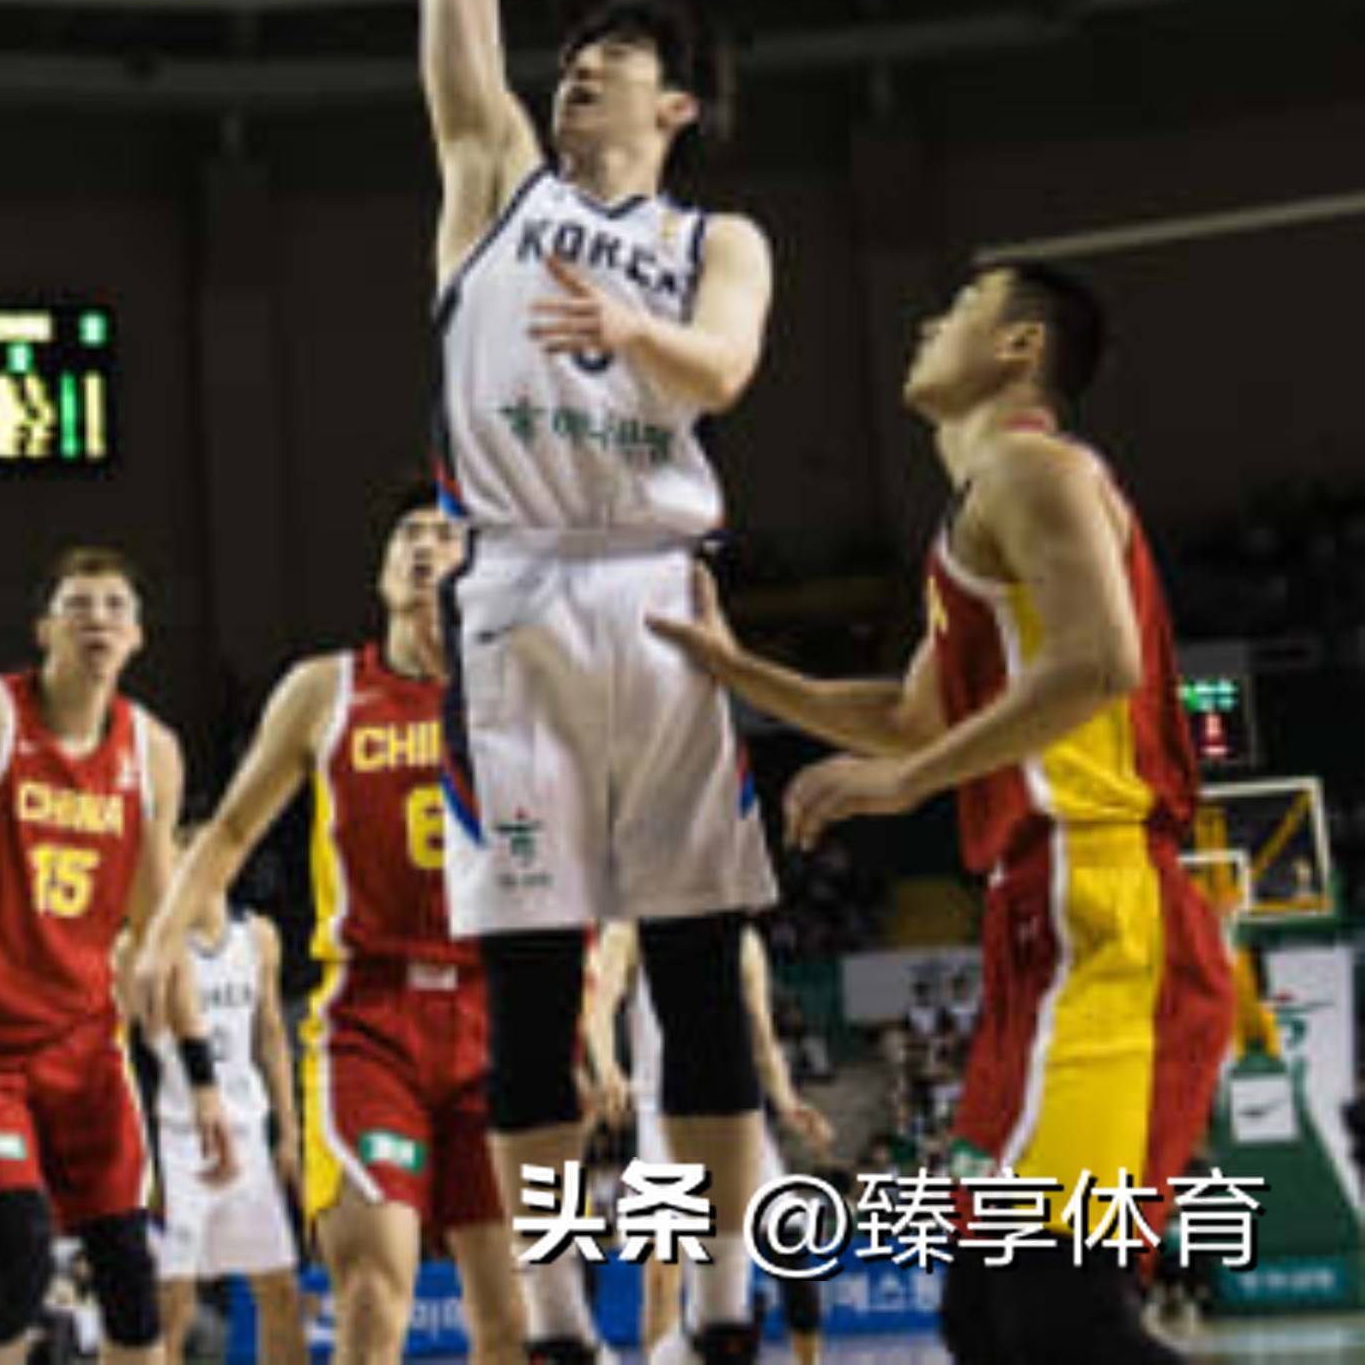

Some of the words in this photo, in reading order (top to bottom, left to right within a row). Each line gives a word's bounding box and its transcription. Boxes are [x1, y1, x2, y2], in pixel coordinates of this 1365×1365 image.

[352, 721, 442, 772] CHI
[19, 780, 125, 839] CHINA
[28, 842, 100, 917] 15
